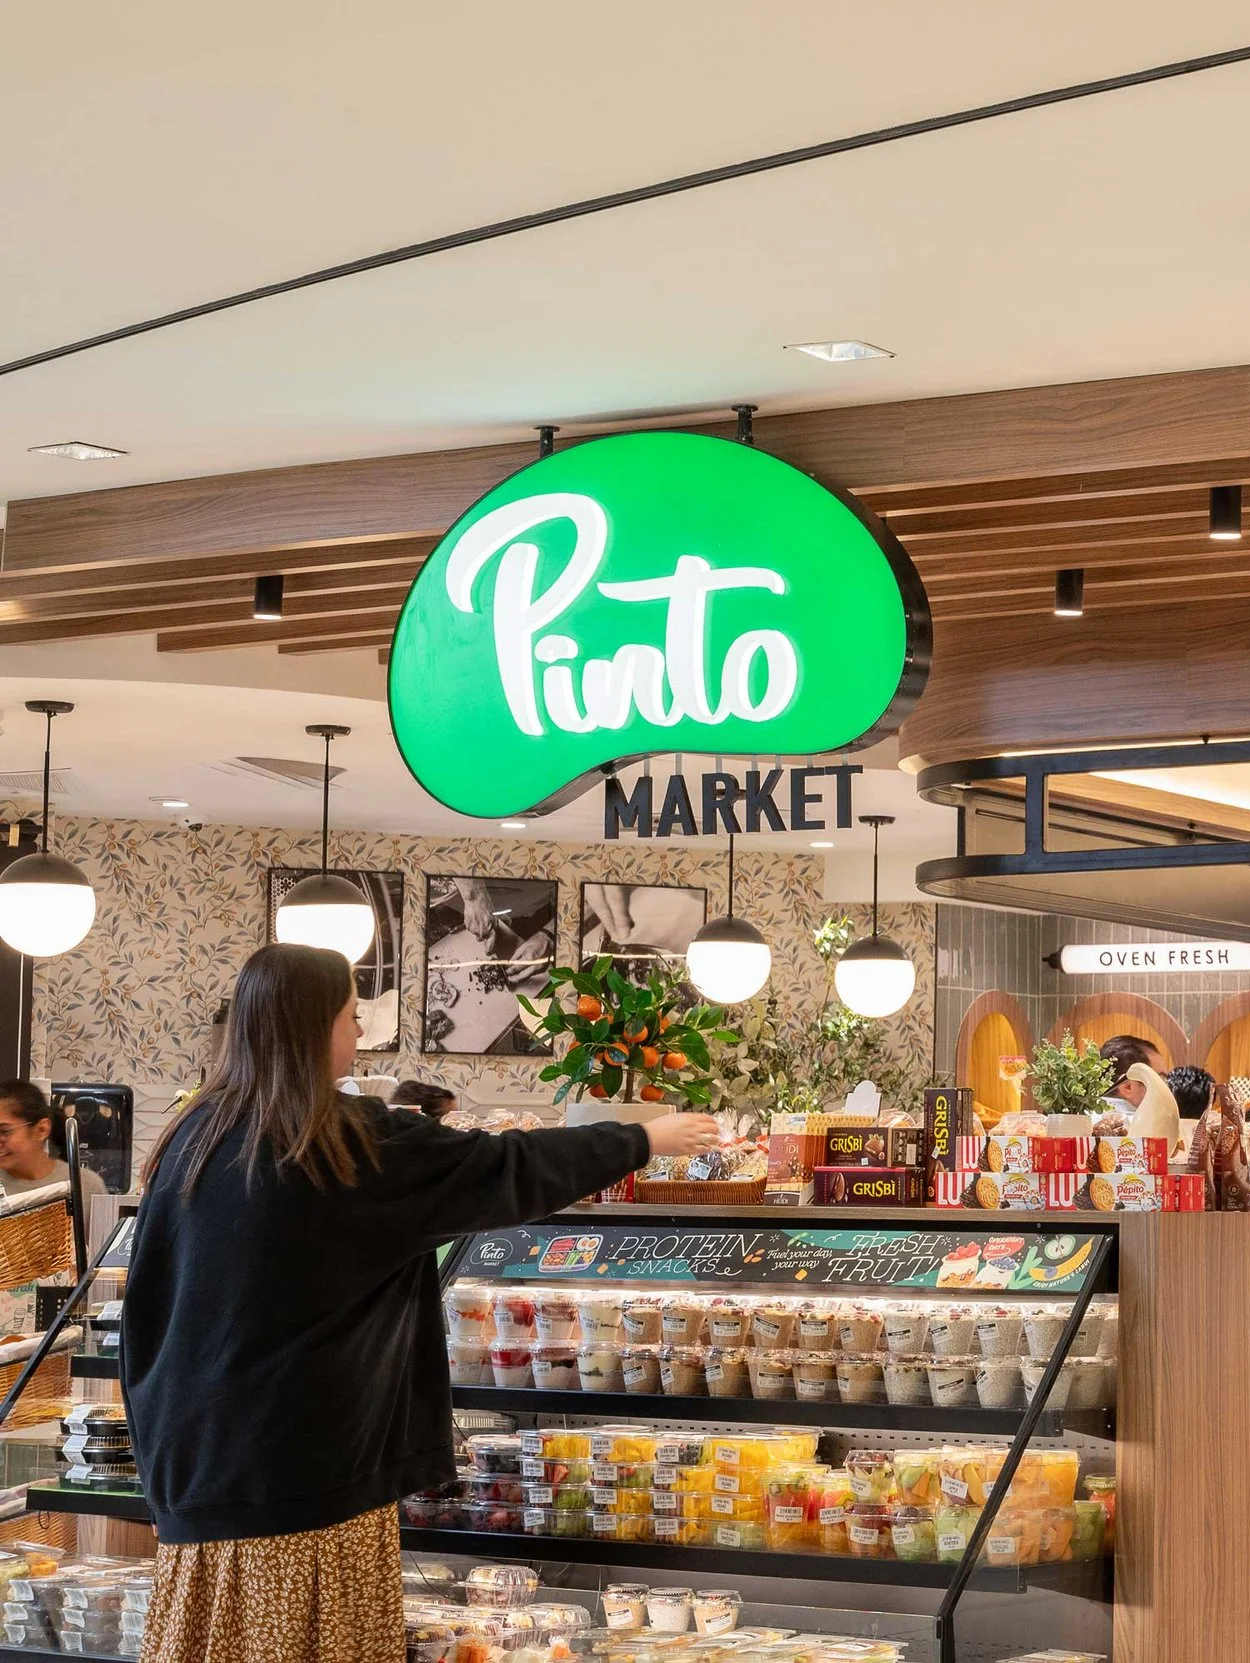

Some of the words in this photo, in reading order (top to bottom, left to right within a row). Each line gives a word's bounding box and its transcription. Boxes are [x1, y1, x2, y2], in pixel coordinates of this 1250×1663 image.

[446, 492, 798, 736] Pinto
[604, 764, 864, 840] MARKET
[1099, 951, 1156, 967] OVEN
[1168, 949, 1230, 965] FRESH
[479, 1242, 506, 1260] Pinto
[608, 1233, 764, 1260] PROTEIN
[847, 1231, 945, 1257] FRESH
[766, 1248, 790, 1260] Fuel
[786, 1249, 813, 1260] your
[627, 1257, 720, 1276] SNACKS
[771, 1261, 799, 1271] your
[798, 1260, 820, 1269] way
